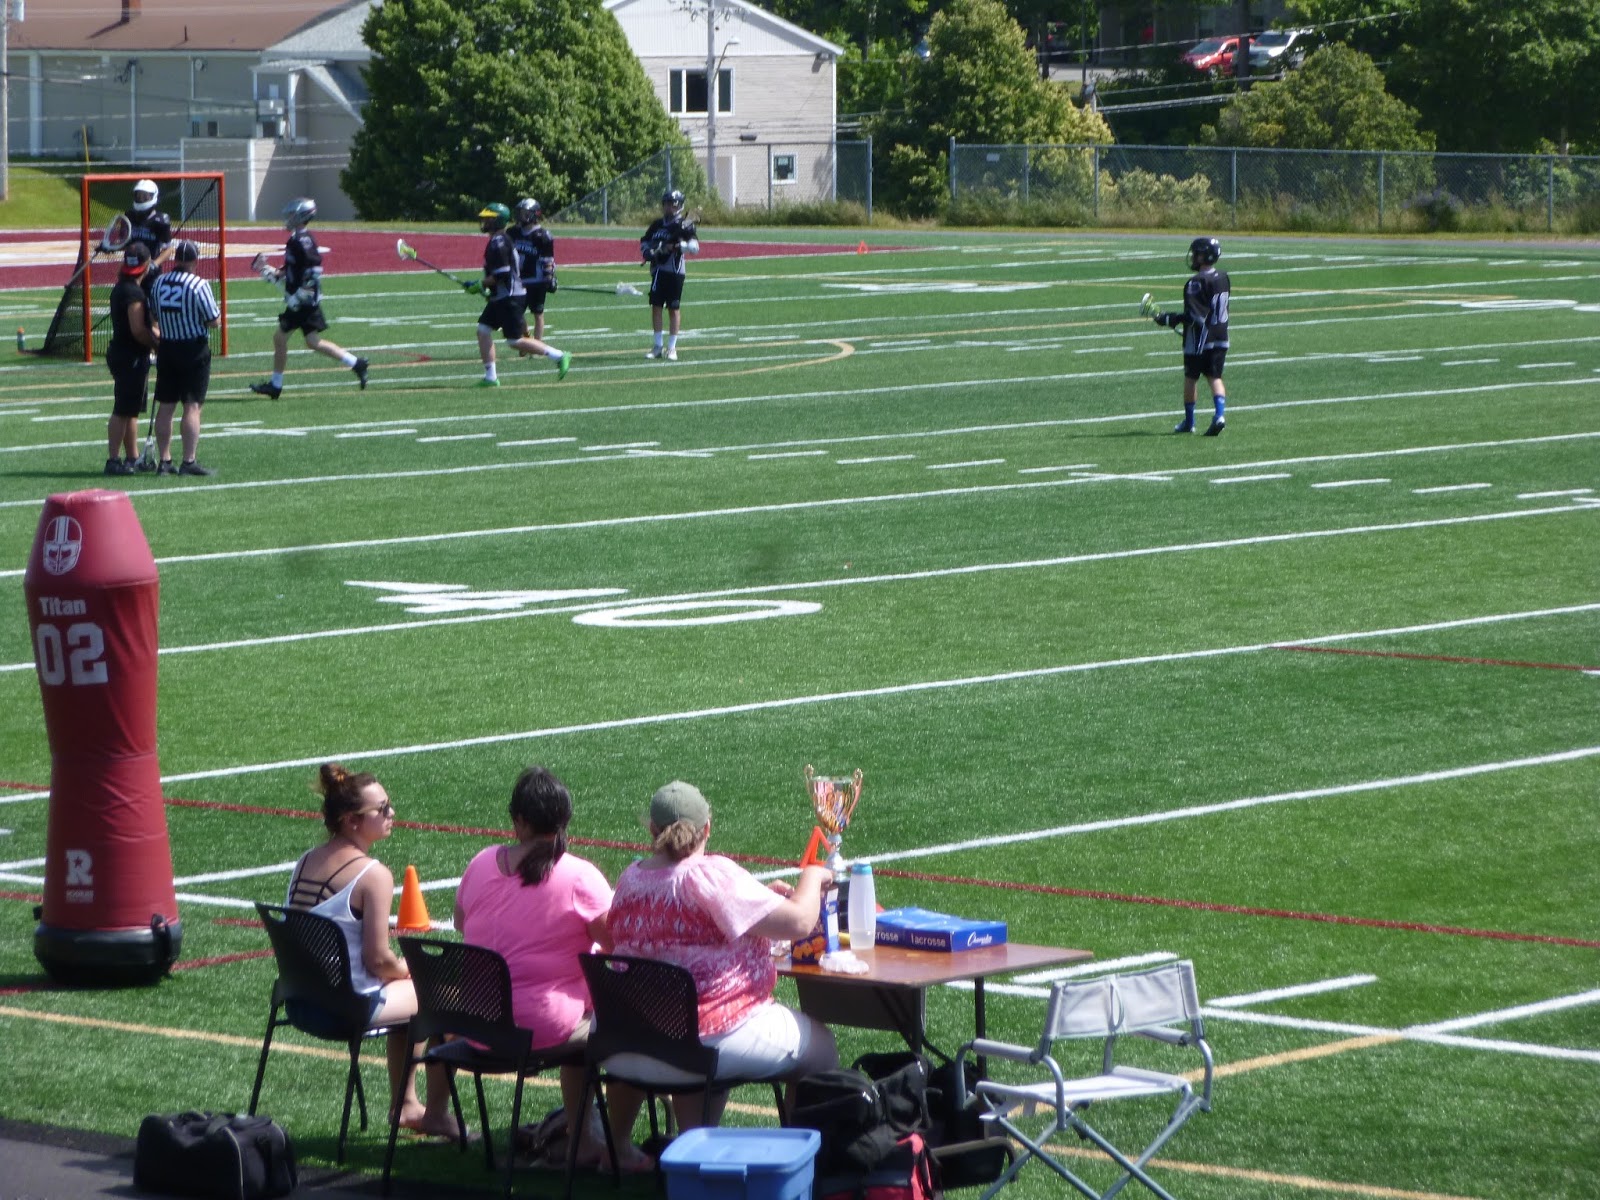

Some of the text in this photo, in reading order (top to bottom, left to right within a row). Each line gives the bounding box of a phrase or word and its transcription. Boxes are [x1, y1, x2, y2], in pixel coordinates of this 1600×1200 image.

[160, 284, 183, 308] 22
[39, 597, 87, 616] Titan
[36, 622, 109, 686] 02
